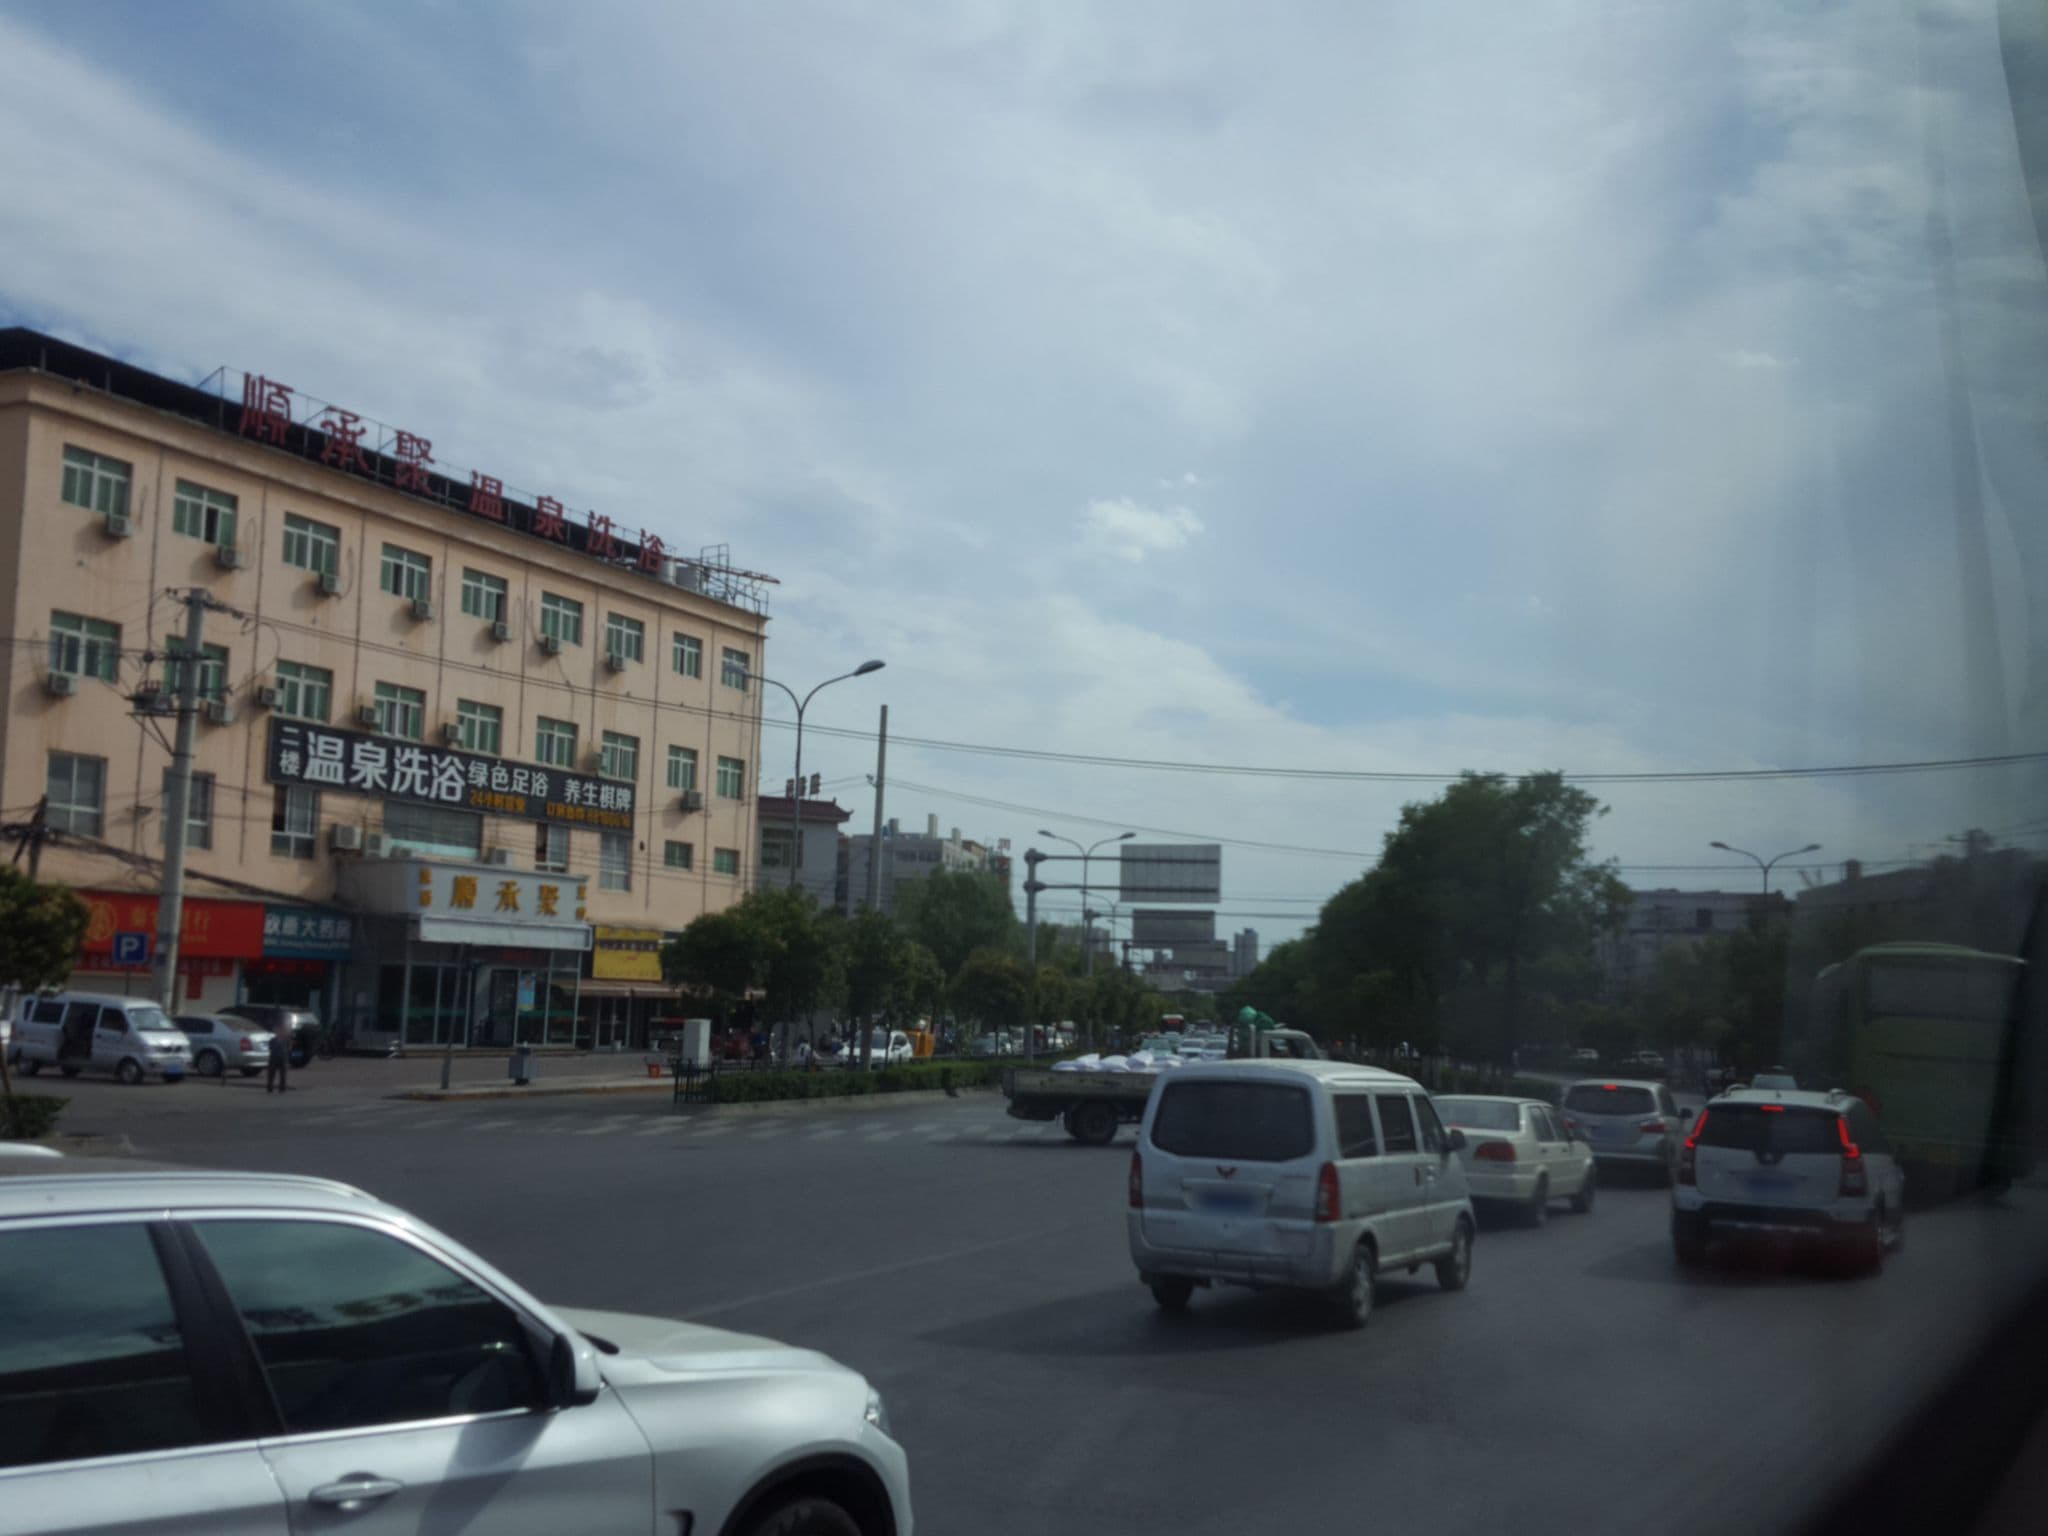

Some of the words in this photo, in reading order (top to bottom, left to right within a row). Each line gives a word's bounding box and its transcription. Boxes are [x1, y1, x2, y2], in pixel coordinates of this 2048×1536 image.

[279, 726, 300, 776] 二楼
[302, 731, 466, 802] 温泉洗浴
[467, 760, 549, 798] 绿色足浴
[563, 778, 632, 812] 养生棋牌
[120, 936, 139, 960] P
